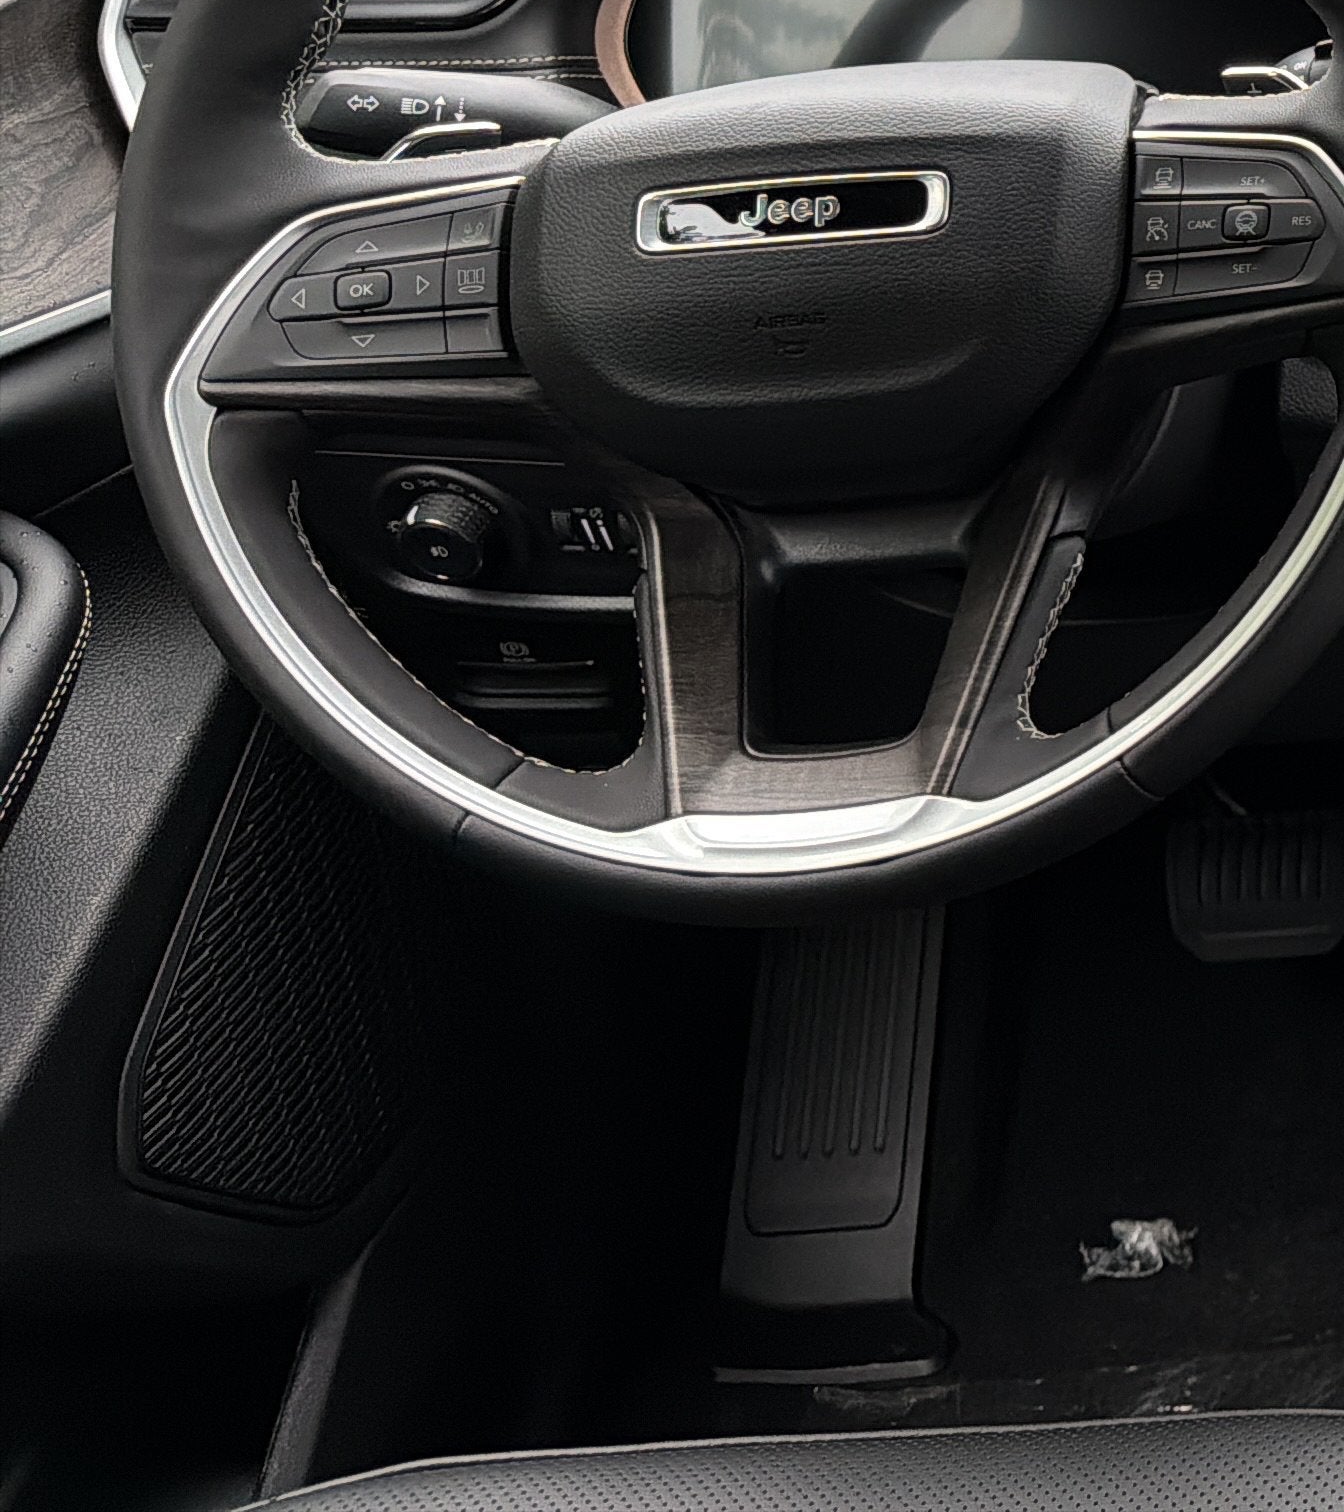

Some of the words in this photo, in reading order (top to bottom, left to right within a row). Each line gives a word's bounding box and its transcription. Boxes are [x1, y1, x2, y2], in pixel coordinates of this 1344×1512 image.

[1239, 176, 1265, 186] SET+
[738, 193, 840, 227] Jeep
[1187, 219, 1217, 230] CANC
[1291, 215, 1311, 226] RES
[350, 283, 374, 297] OK
